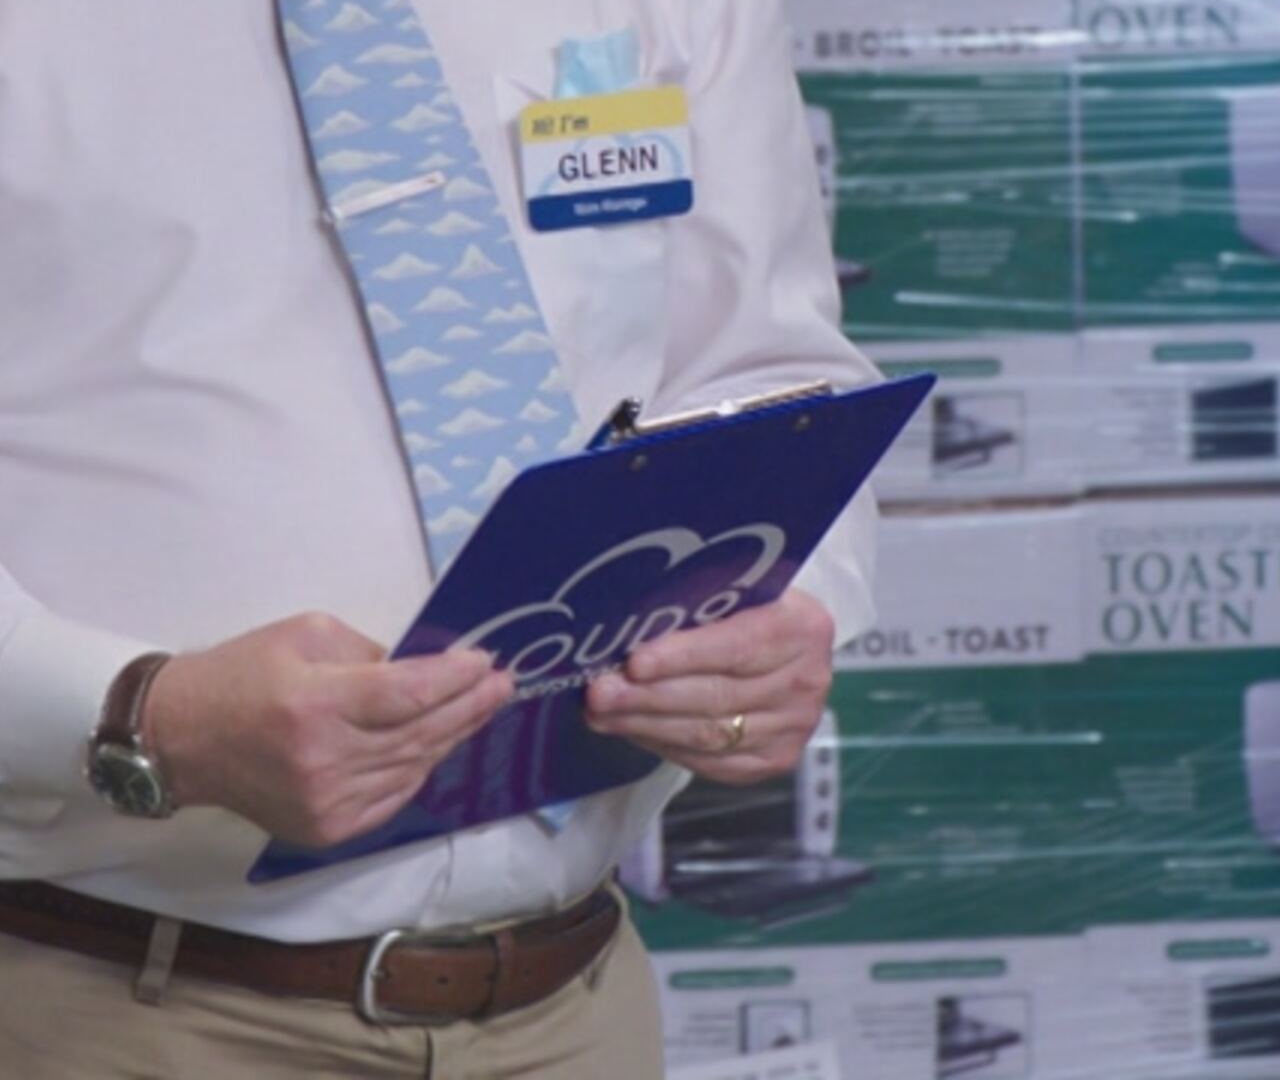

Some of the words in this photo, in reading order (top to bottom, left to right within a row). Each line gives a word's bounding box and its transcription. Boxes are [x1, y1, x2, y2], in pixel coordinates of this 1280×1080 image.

[1089, 5, 1239, 49] OVEN
[557, 143, 659, 183] GLENN
[946, 625, 1049, 653] TOAST
[1100, 600, 1256, 647] OVEN
